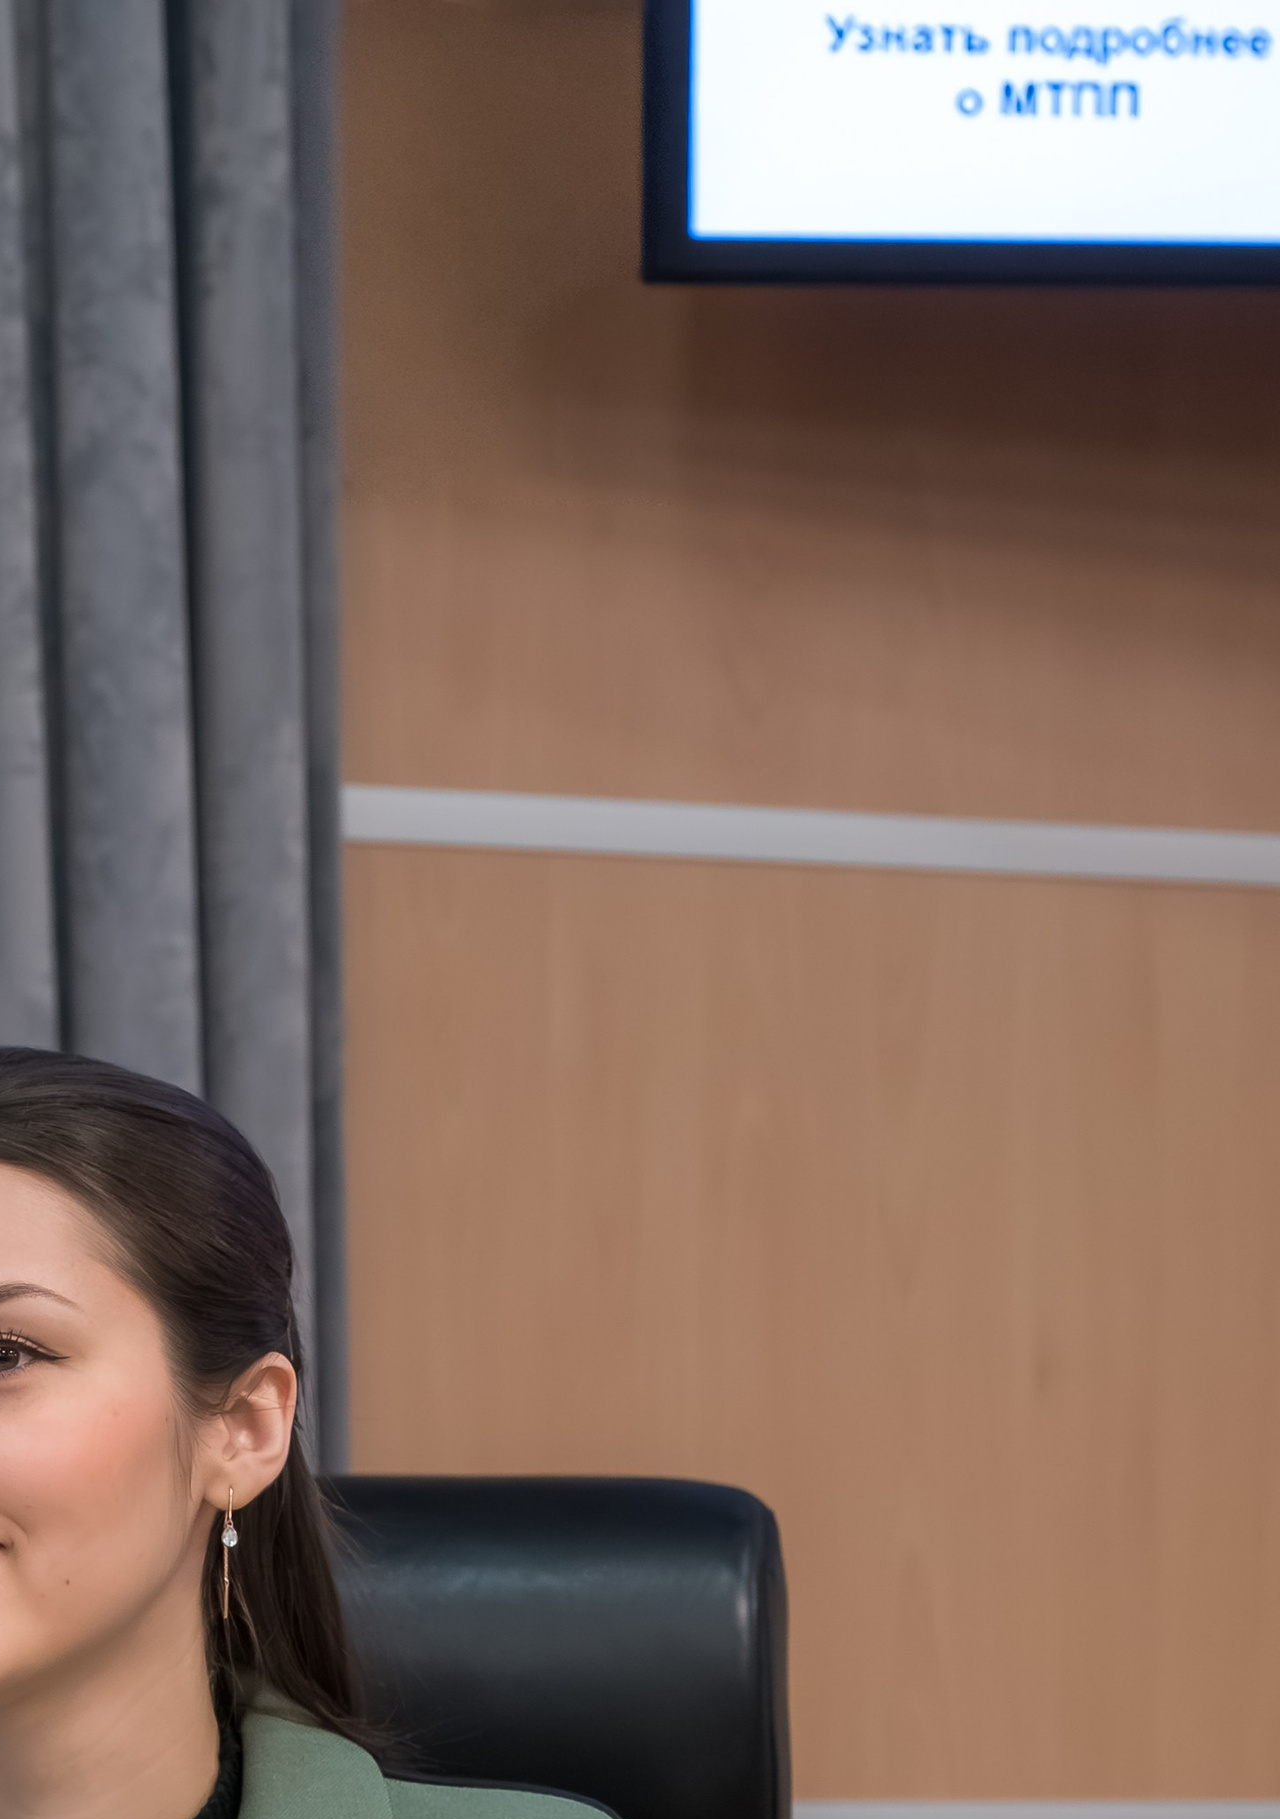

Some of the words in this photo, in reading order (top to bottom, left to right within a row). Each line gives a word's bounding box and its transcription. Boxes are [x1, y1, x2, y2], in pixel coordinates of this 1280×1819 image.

[824, 13, 991, 54] Узнать
[1007, 16, 1274, 66] подробнее
[956, 87, 984, 117] о
[999, 80, 1140, 118] МТПП
